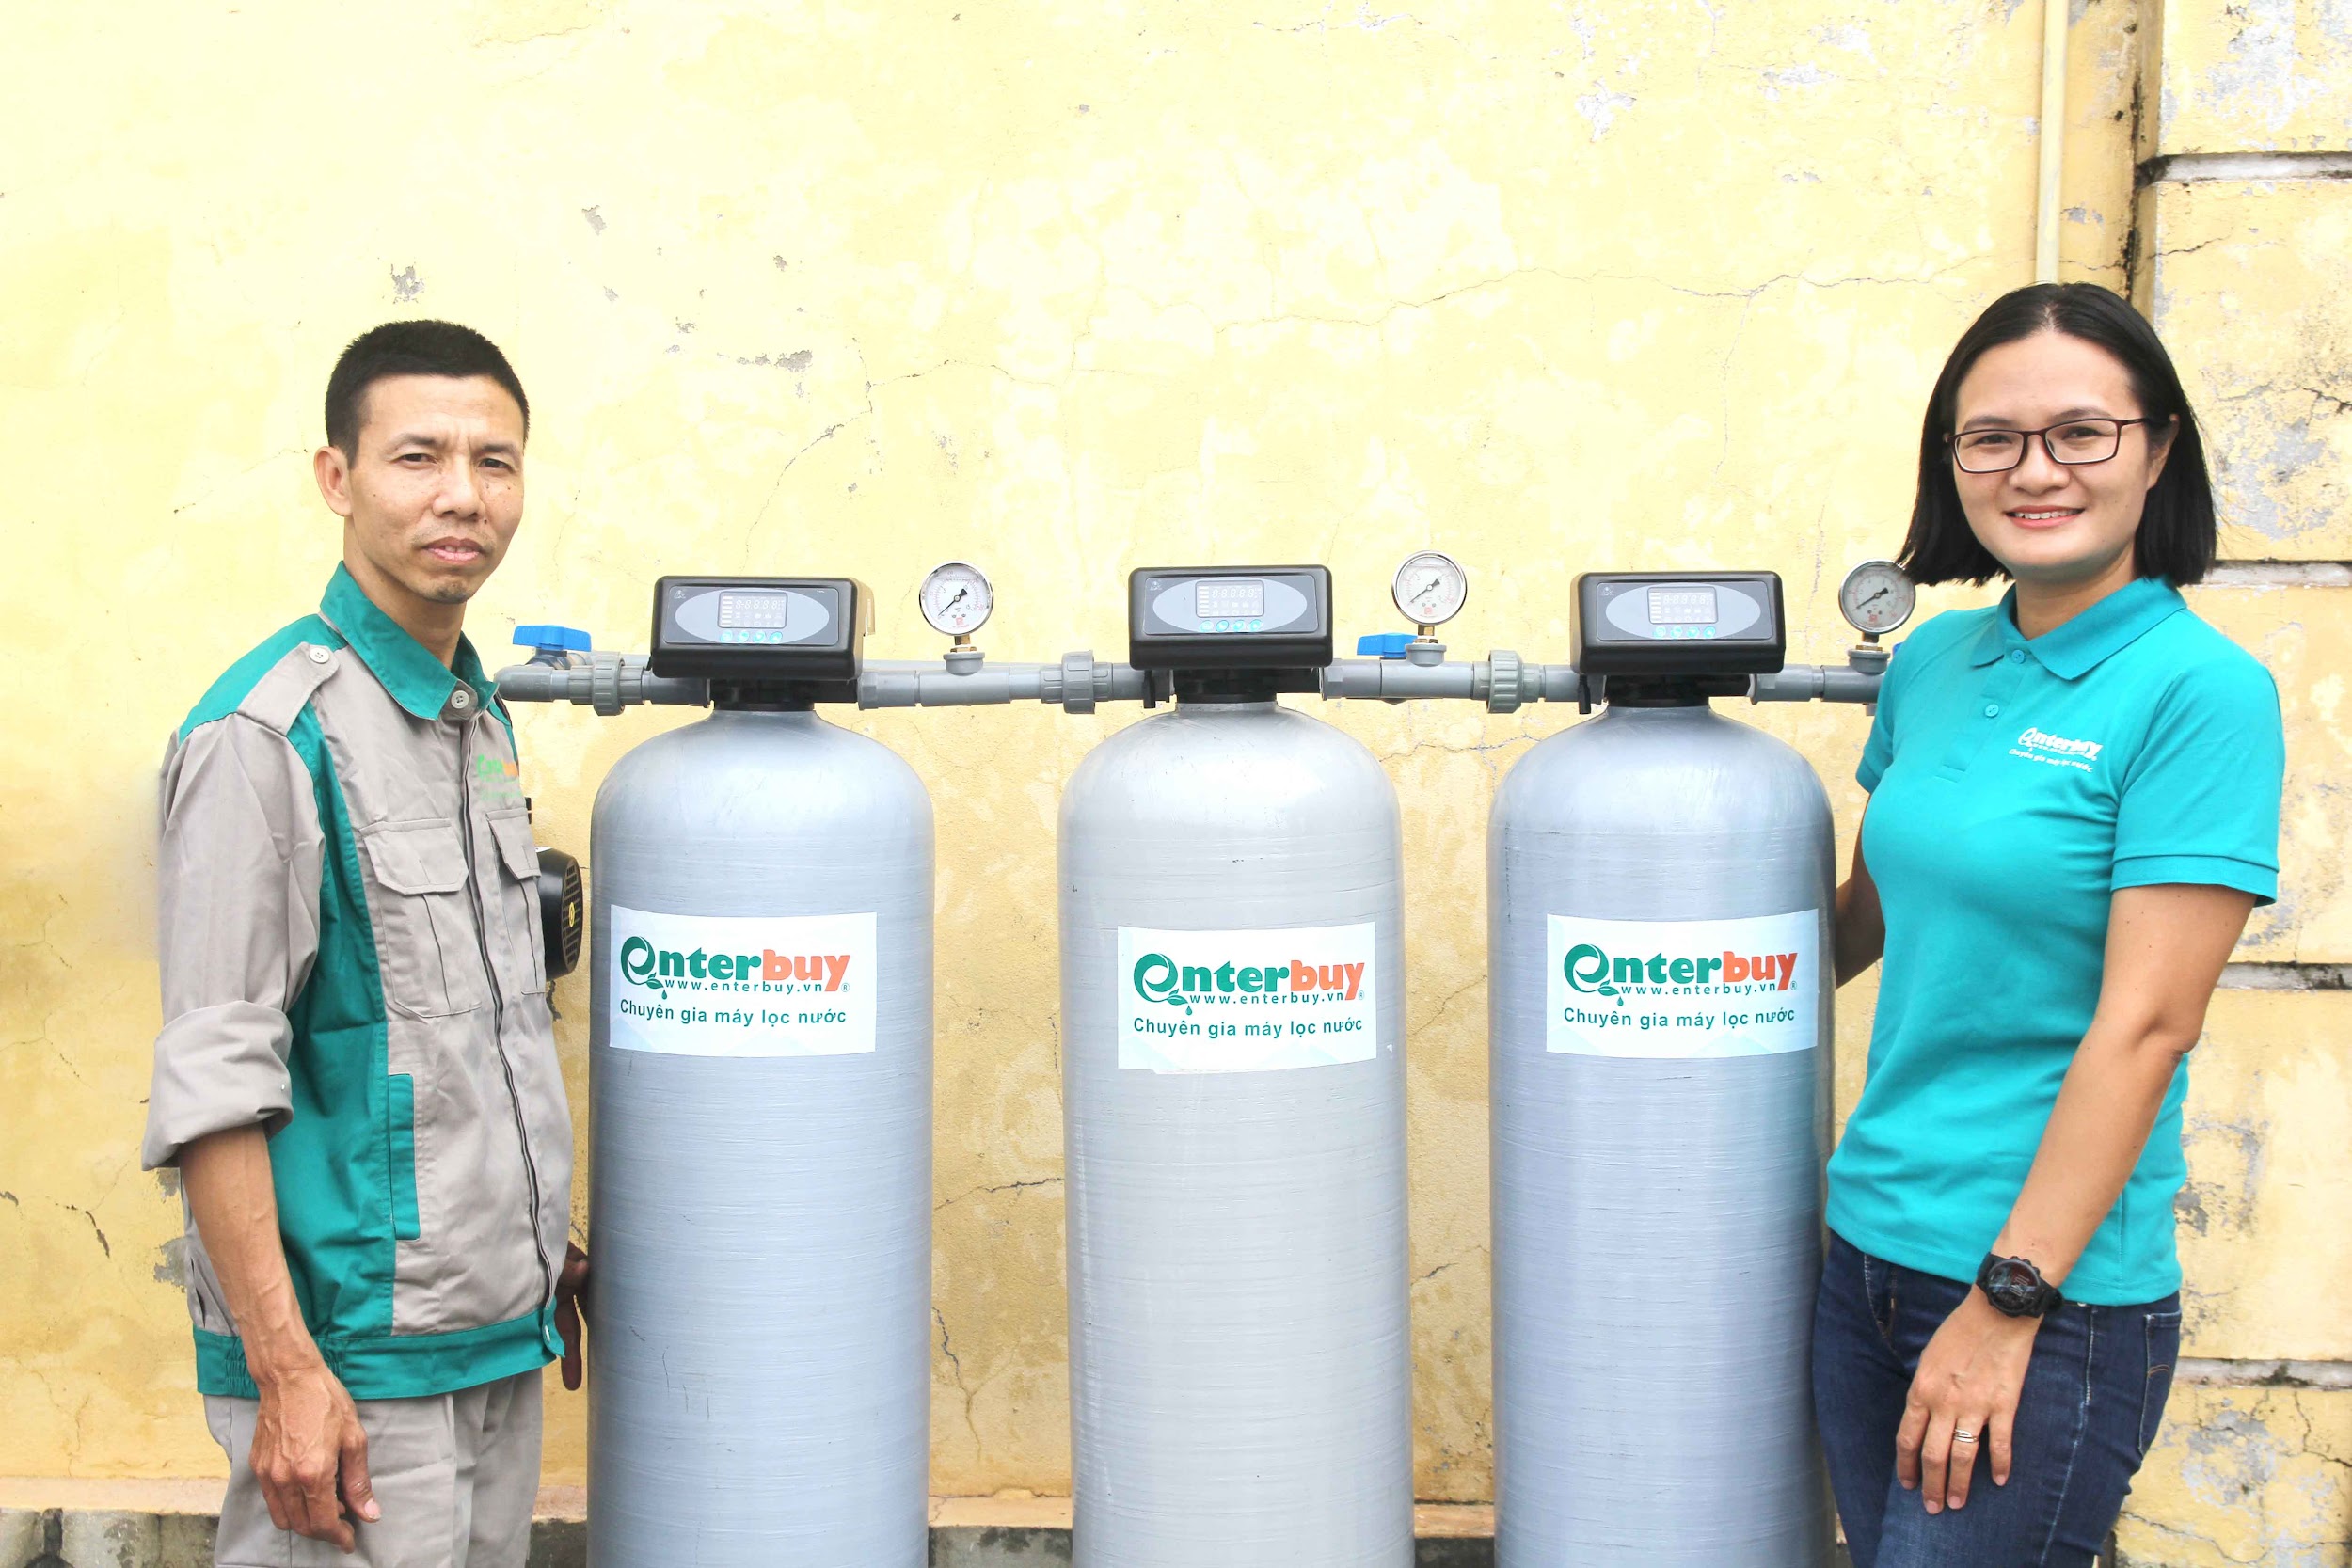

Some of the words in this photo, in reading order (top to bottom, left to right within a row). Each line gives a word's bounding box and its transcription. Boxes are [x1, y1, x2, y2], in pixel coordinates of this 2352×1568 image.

[621, 936, 850, 991] enterbuy
[1564, 943, 1798, 993] enterbuy
[665, 978, 822, 994] www.enterbuy.vn
[1133, 953, 1365, 1003] enterbuy
[1621, 982, 1776, 996] www.enterbuy.vn
[1190, 991, 1343, 1005] www.enterbuy.vn
[620, 998, 674, 1021] Chuyên
[681, 1007, 707, 1024] gia
[715, 1009, 754, 1027] máy
[761, 1009, 790, 1027] lọc
[798, 1008, 847, 1023] nước
[1564, 1007, 1631, 1028] Chuyên
[1640, 1012, 1668, 1030] gia
[1677, 1012, 1715, 1030] máy
[1723, 1010, 1749, 1029] lọc
[1756, 1006, 1795, 1023] nước
[1133, 1017, 1200, 1037] Chuyên
[1208, 1022, 1236, 1038] gia
[1245, 1022, 1282, 1038] máy
[1290, 1021, 1316, 1037] lọc
[1323, 1017, 1363, 1033] nước
